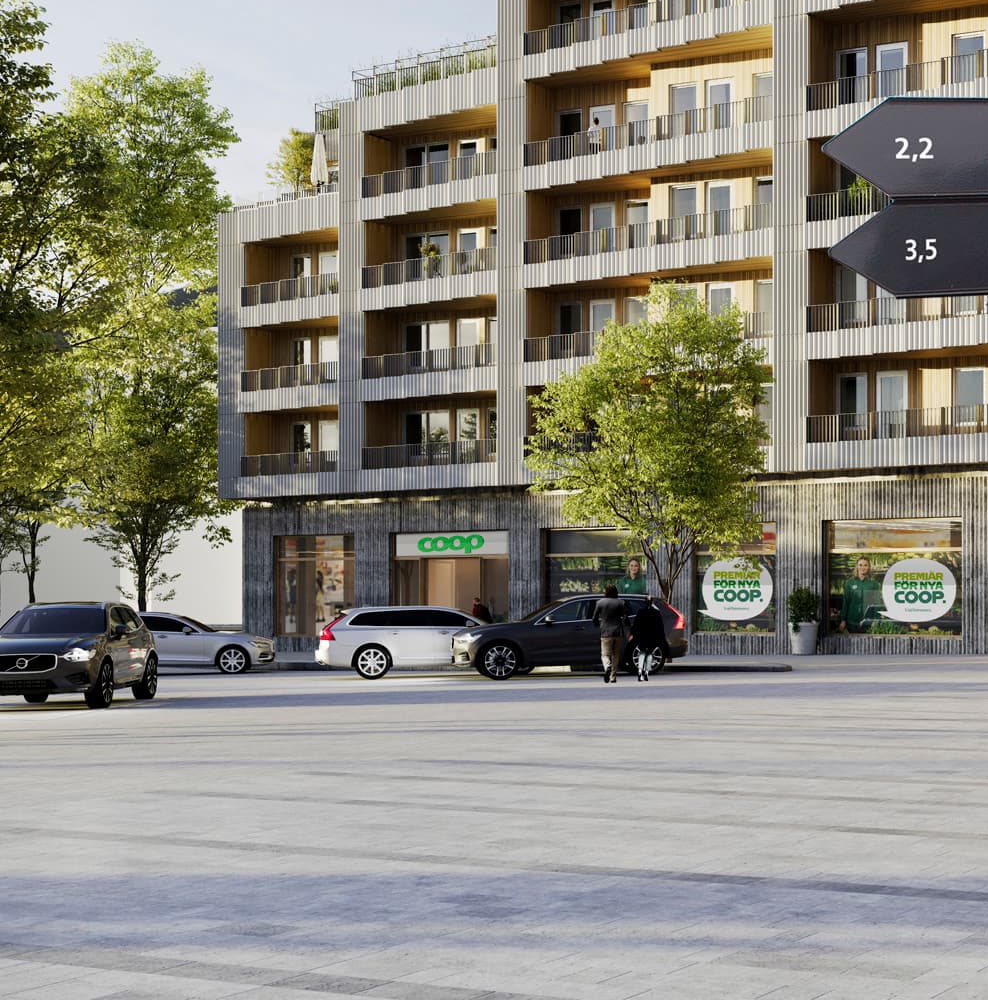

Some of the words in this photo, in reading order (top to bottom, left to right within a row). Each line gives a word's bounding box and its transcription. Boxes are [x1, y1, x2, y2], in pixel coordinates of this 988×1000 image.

[894, 136, 935, 163] 2,2
[905, 238, 938, 264] 3,5
[417, 534, 485, 554] coop
[738, 580, 761, 589] NYA
[920, 581, 944, 590] NYA
[713, 589, 764, 602] COOP.
[894, 590, 947, 604] COOP.
